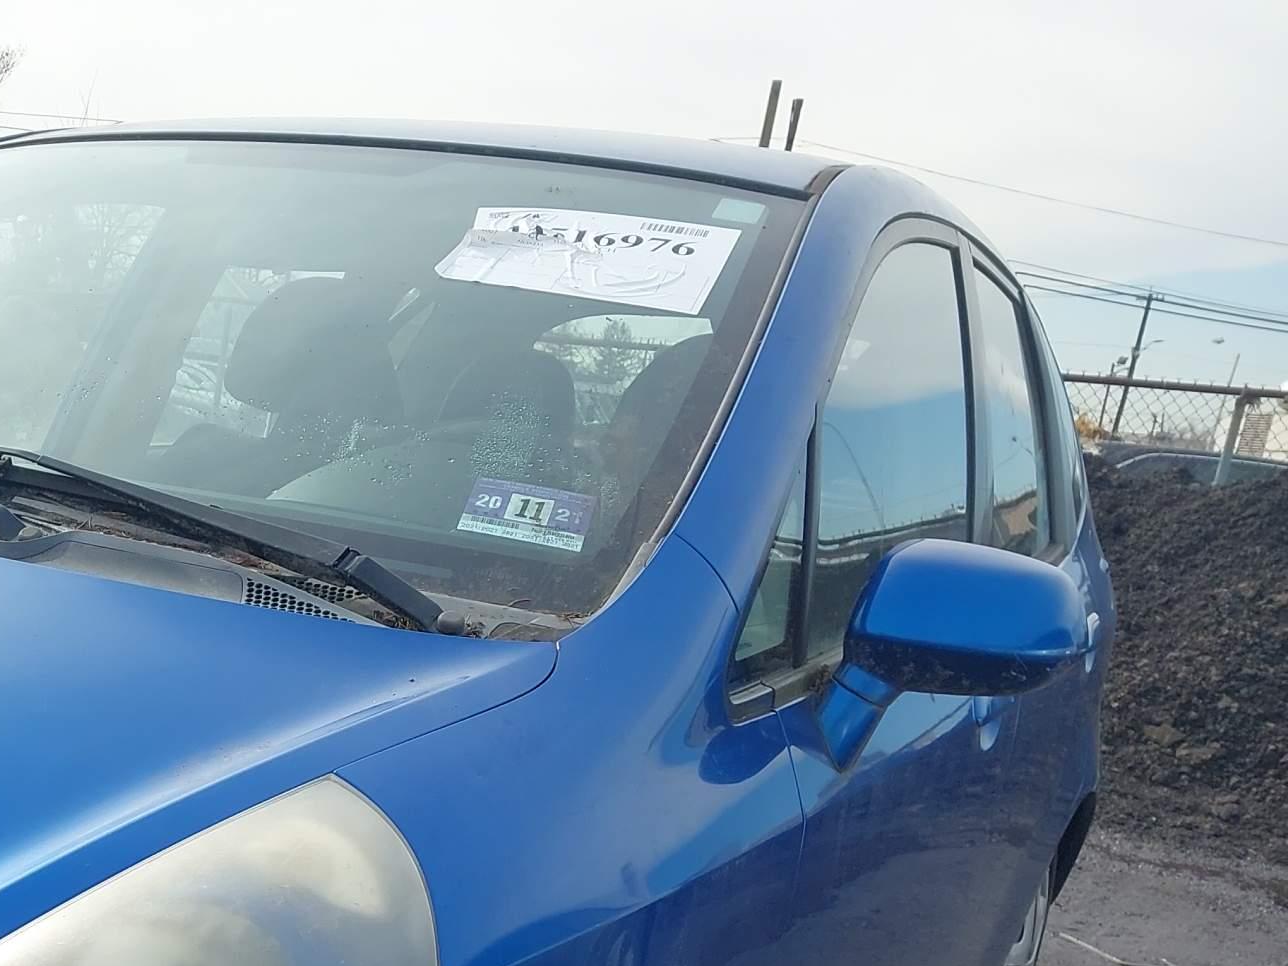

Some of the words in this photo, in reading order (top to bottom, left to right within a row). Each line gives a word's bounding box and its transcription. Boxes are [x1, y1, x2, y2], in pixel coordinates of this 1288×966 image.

[507, 223, 699, 257] 16976
[474, 493, 503, 510] 20
[514, 498, 546, 523] 11
